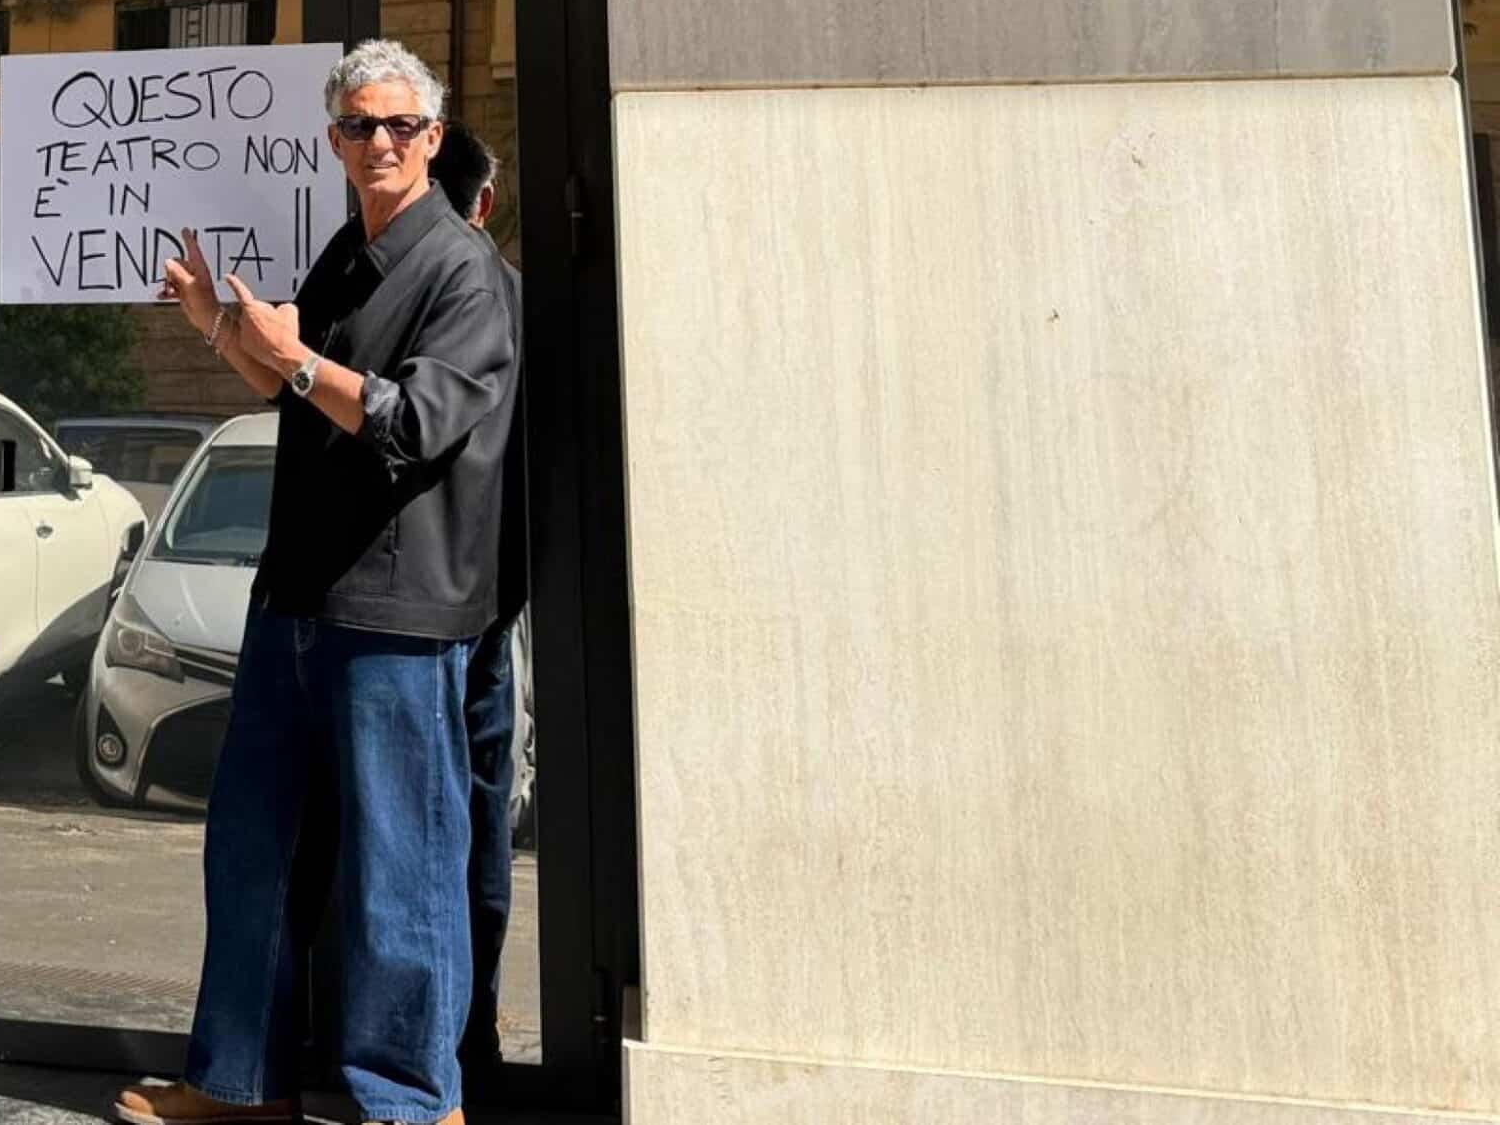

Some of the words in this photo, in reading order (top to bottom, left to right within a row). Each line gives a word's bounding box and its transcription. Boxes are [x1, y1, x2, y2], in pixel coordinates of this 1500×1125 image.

[51, 65, 274, 129] QUESTO
[36, 135, 221, 177] TEATRO
[244, 134, 319, 176] NON
[109, 182, 151, 216] IN
[31, 225, 275, 291] VENDTA
